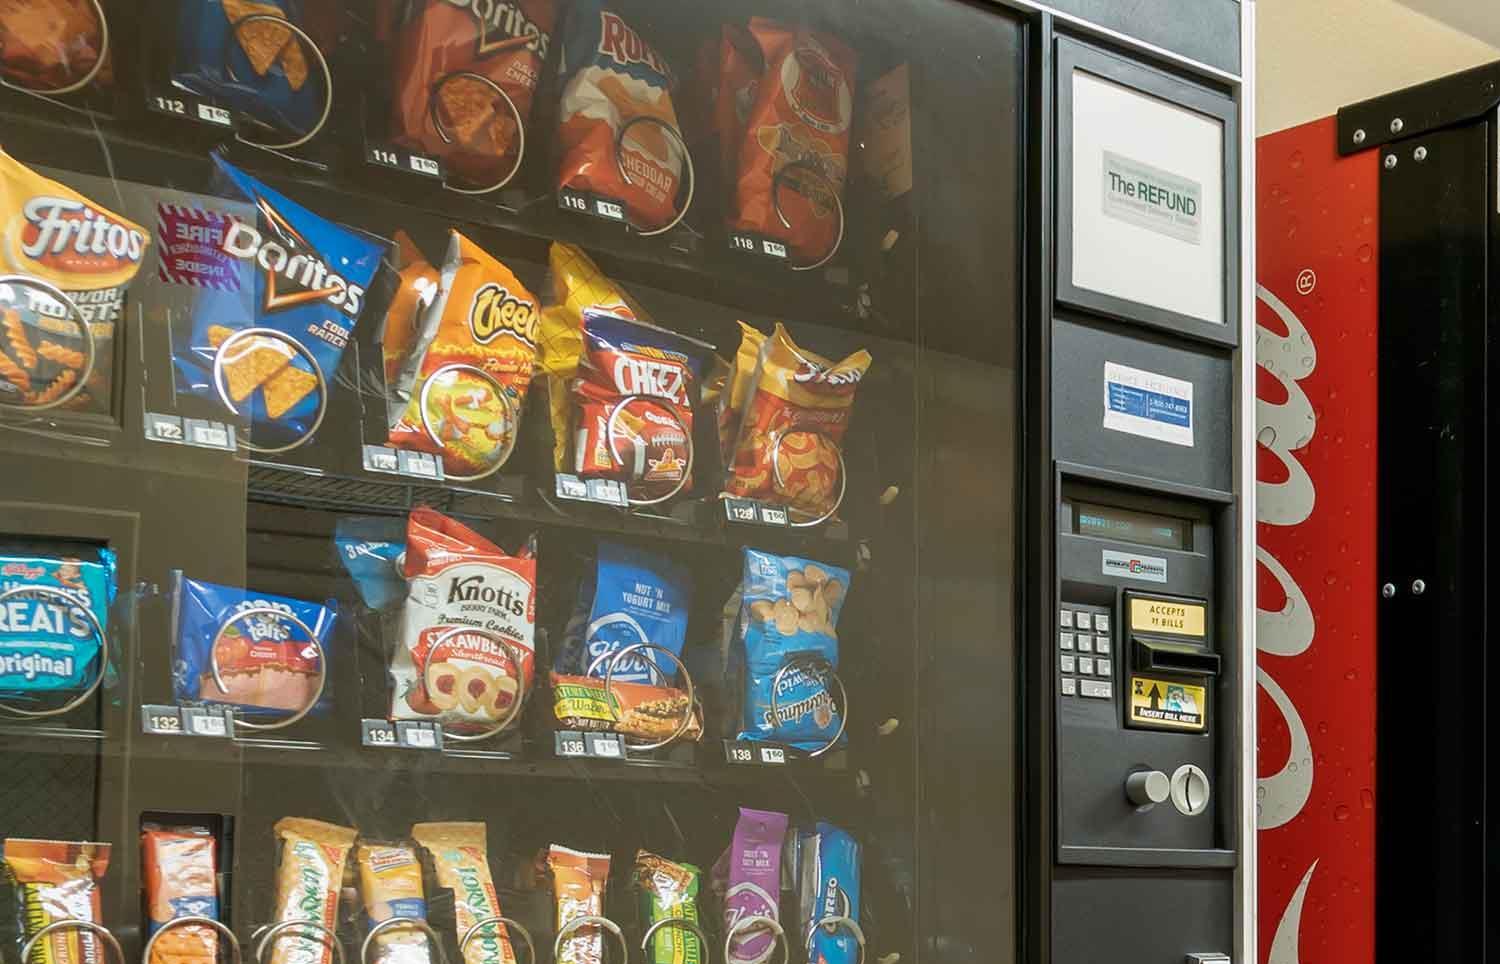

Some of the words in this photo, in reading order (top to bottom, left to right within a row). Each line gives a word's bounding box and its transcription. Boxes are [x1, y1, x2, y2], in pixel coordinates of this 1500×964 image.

[156, 98, 184, 114] 112
[373, 150, 397, 165] 114
[563, 196, 586, 210] 116
[1109, 171, 1135, 197] The
[1137, 182, 1197, 217] REFUND
[23, 197, 146, 262] Fritos
[734, 237, 753, 250] 118
[223, 222, 365, 315] Doritos
[468, 283, 541, 348] Cheet
[308, 324, 348, 349] RANCH
[323, 319, 353, 341] COOL
[448, 576, 525, 617] Knott's
[635, 583, 652, 595] NUT
[622, 592, 654, 609] YOGURT
[655, 601, 672, 614] MIX
[1150, 605, 1185, 617] ACCEPTS
[437, 614, 484, 630] Premium
[486, 620, 525, 642] Cookies
[1162, 618, 1184, 629] BILLS
[427, 631, 529, 662] STRAWBERRY
[0, 652, 73, 680] original
[451, 648, 506, 667] Shortbread
[151, 716, 179, 730] 132
[1140, 707, 1164, 719] INSERT
[1165, 711, 1179, 721] BILL
[1180, 714, 1197, 724] HERE
[369, 728, 395, 743] 134
[562, 741, 585, 754] 136
[732, 749, 752, 761] 138
